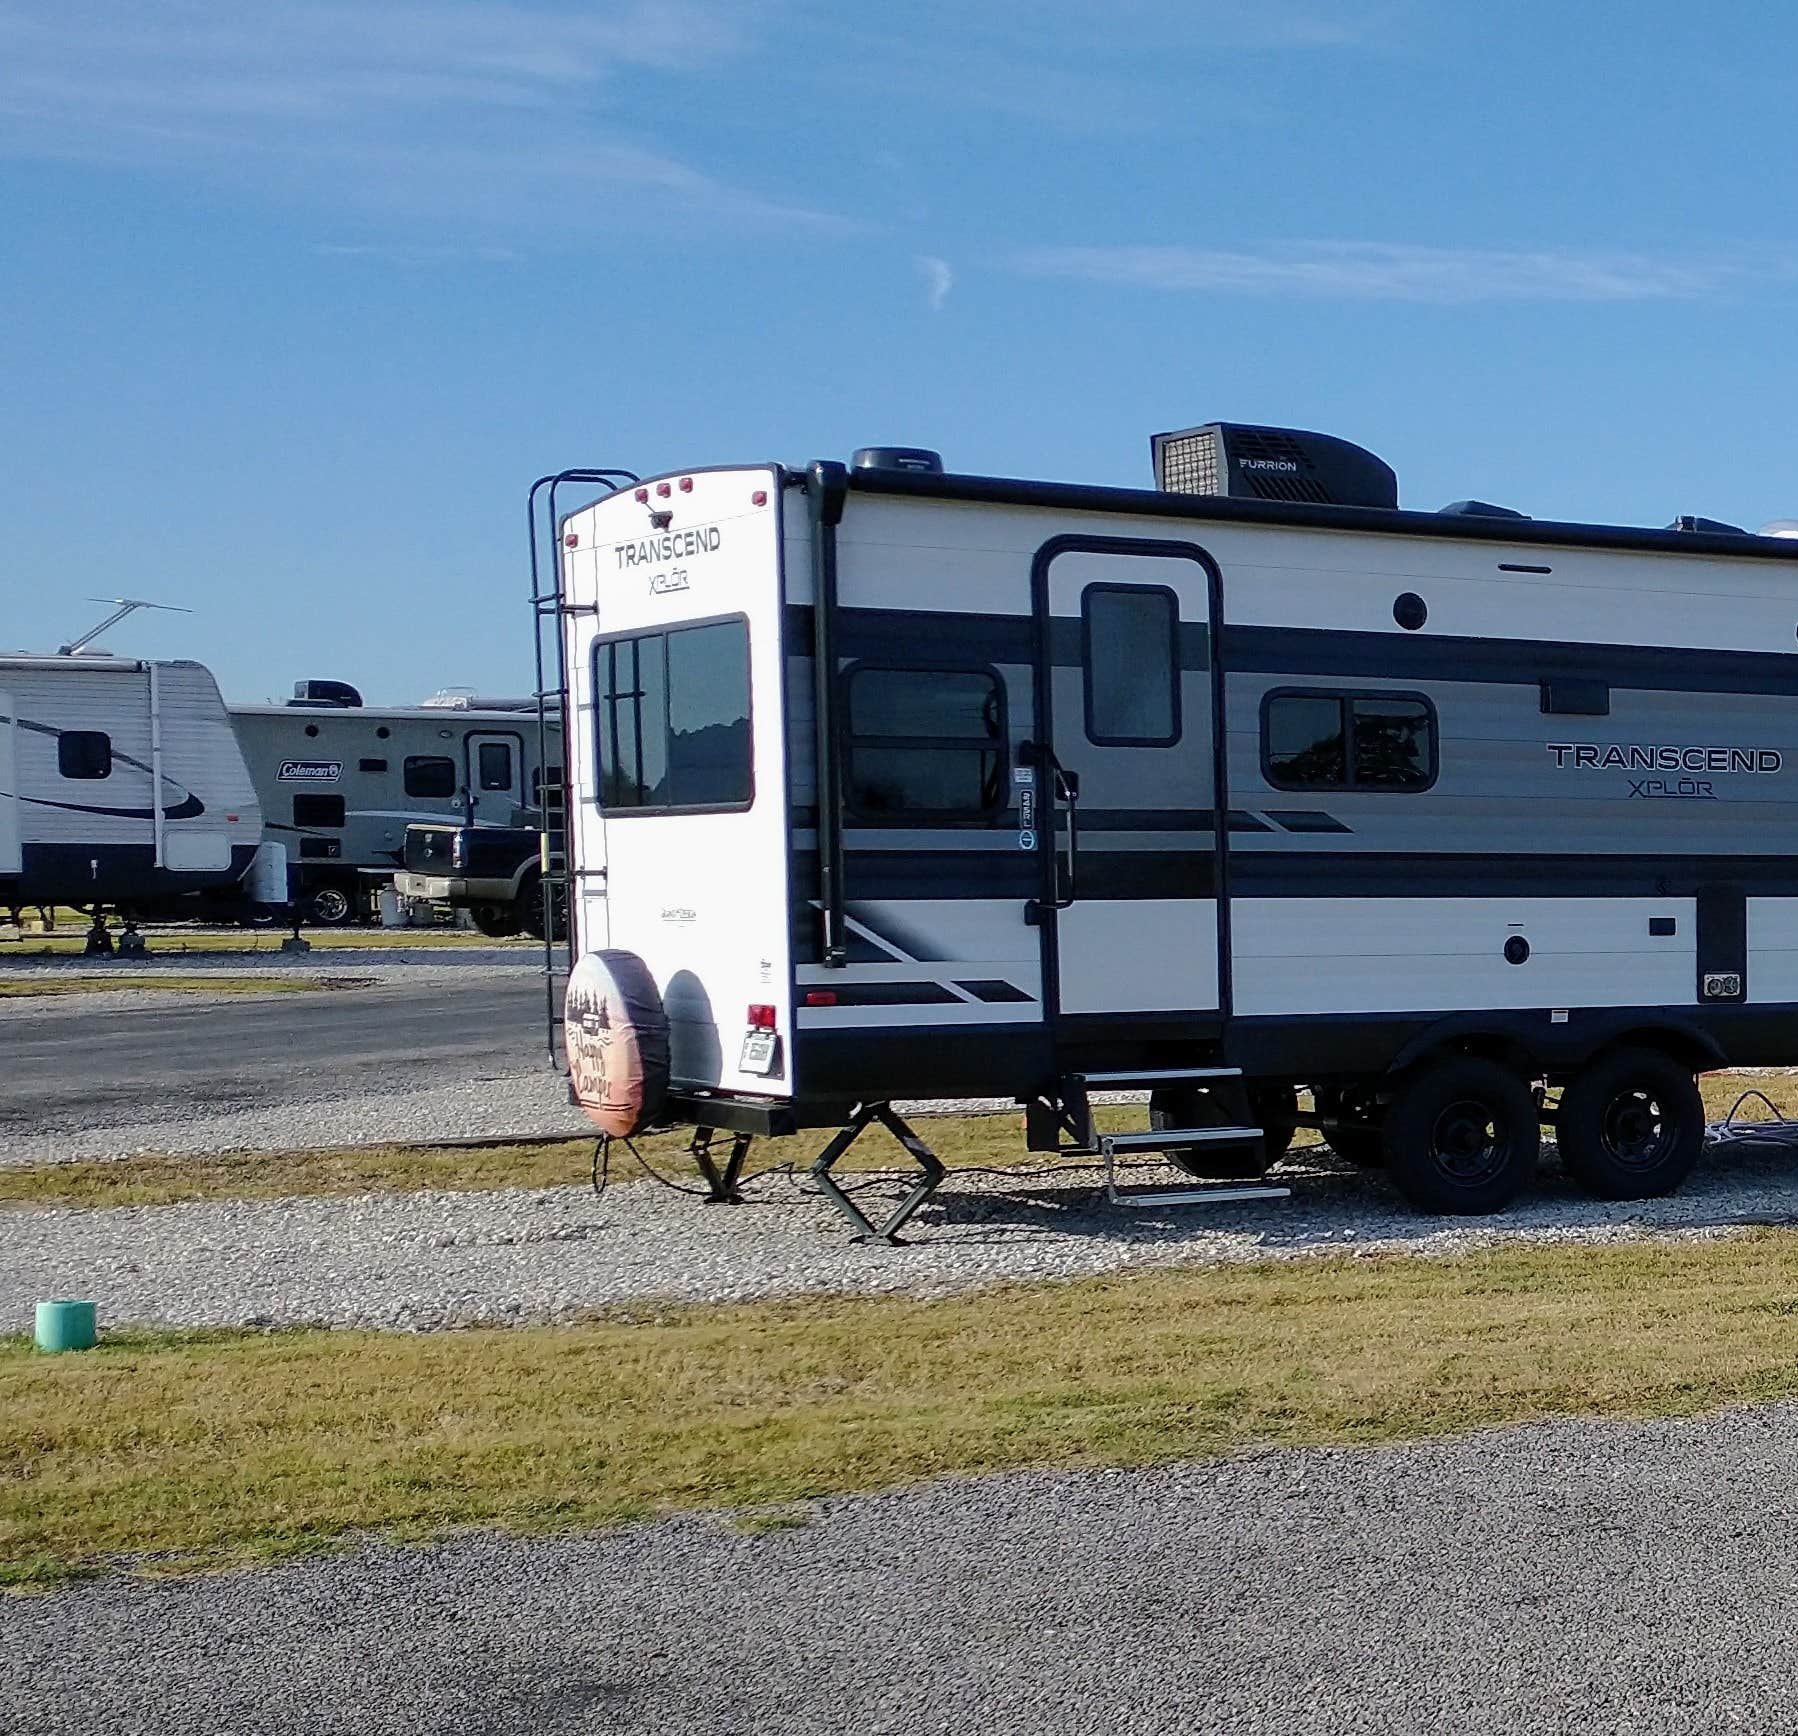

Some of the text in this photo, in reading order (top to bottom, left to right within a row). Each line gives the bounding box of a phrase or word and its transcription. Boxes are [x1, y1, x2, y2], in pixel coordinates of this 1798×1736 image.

[1239, 458, 1297, 472] FURRION
[615, 526, 721, 570] TRANSCEND
[1547, 743, 1783, 774] TRANSCEND
[282, 763, 329, 777] Coleman
